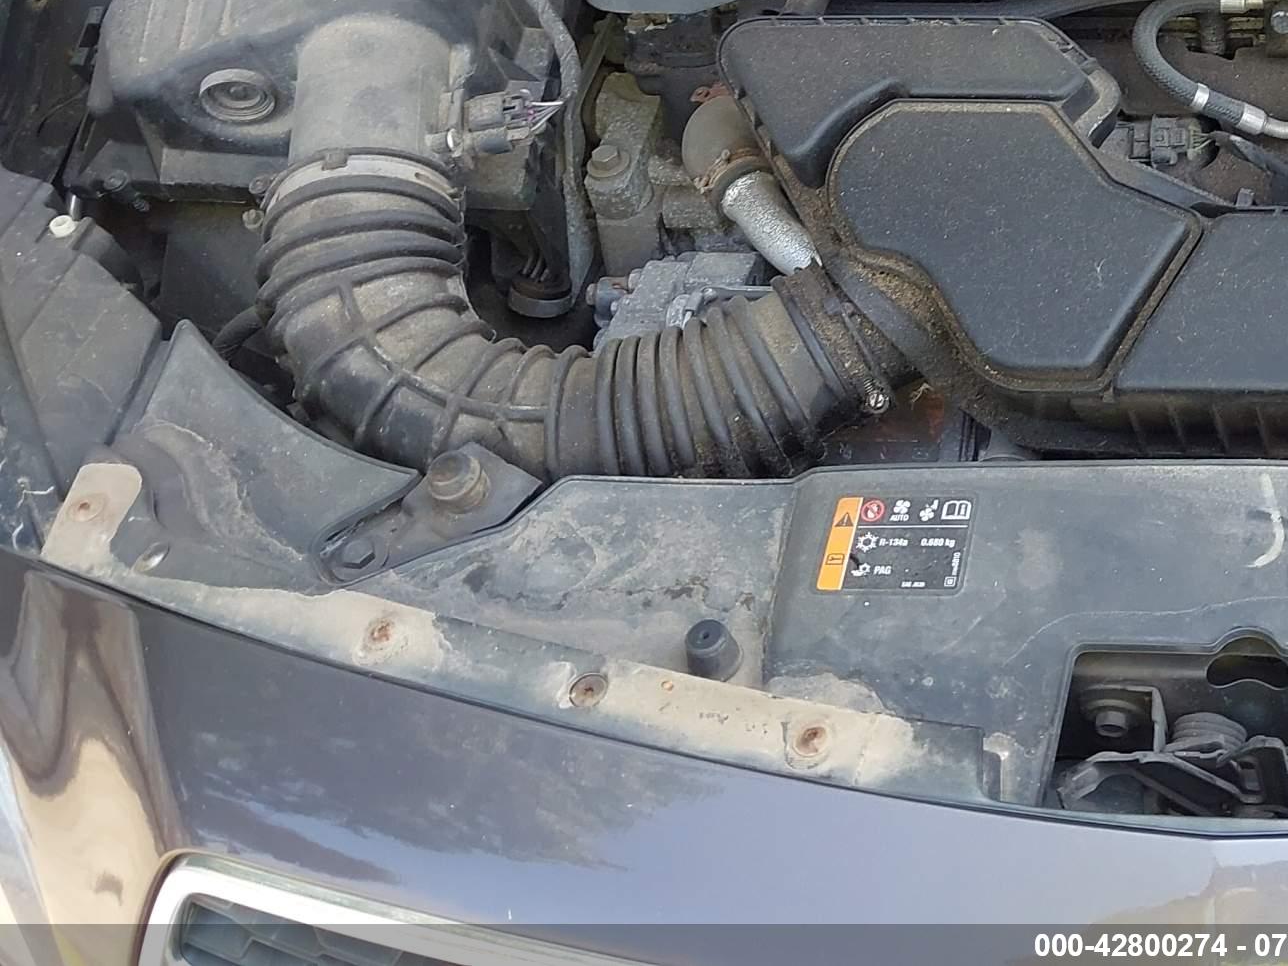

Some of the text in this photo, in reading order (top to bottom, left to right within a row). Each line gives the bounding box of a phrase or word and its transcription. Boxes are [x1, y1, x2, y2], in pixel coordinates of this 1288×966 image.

[879, 538, 908, 546] R-134a
[945, 538, 956, 548] kg
[873, 566, 892, 575] PAG
